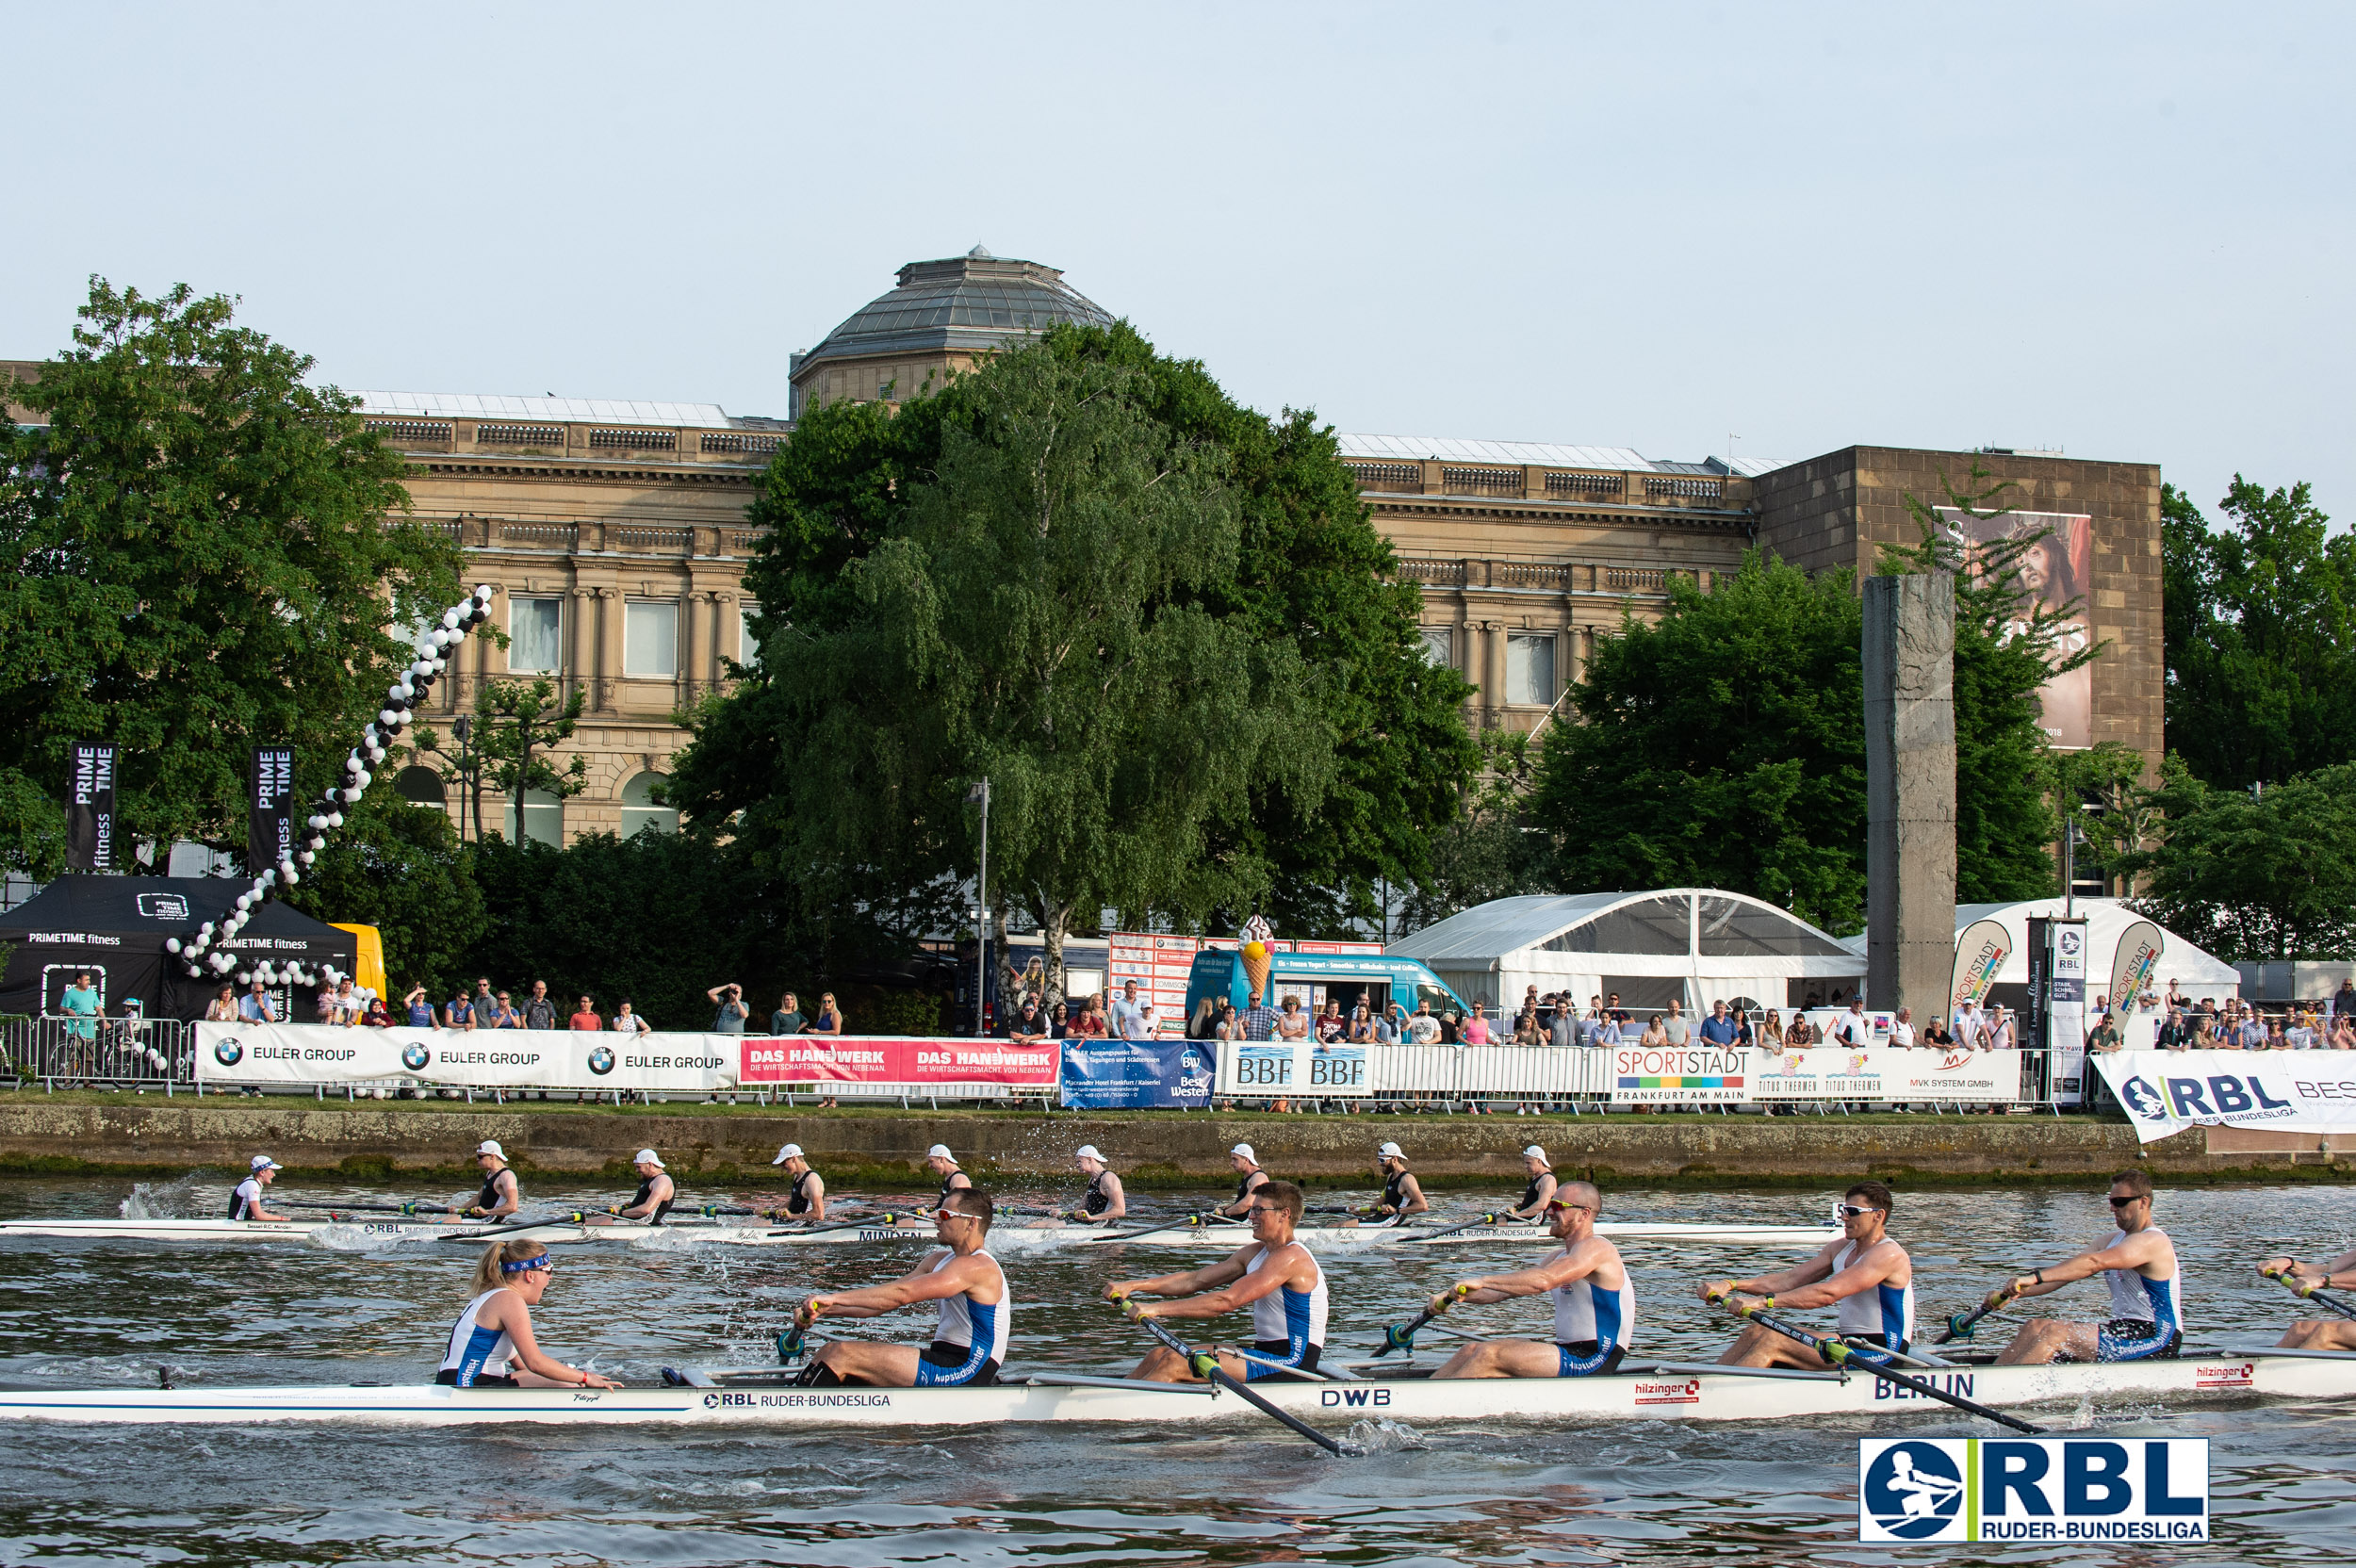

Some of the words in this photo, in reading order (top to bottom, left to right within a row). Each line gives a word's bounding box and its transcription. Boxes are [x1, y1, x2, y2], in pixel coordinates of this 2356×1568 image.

[76, 747, 94, 804] PRIME
[95, 748, 113, 792] TIME
[277, 751, 290, 796] TIME
[259, 751, 274, 809] PRIME
[94, 813, 110, 867] fitness
[276, 817, 289, 861] tness
[29, 933, 86, 943] PRIMETIME
[87, 934, 120, 946] fitness
[216, 938, 272, 949] PRIMETIME
[274, 939, 308, 949] fitness
[1989, 970, 1996, 979] AM
[1996, 952, 2008, 968] MAIN
[2059, 960, 2079, 968] RBL
[1952, 939, 1997, 1006] SPORTSTADT
[2111, 939, 2151, 1008] SPORTSTADT
[2126, 981, 2144, 1015] FRANKFURT
[2143, 970, 2150, 979] AM
[2149, 952, 2160, 968] MAIN
[254, 1047, 300, 1060] EULER
[304, 1049, 356, 1061] GROUP
[441, 1052, 488, 1064] EULER
[490, 1053, 540, 1065] GROUP
[750, 1050, 784, 1062] DAS
[789, 1046, 885, 1063] HANDWERK
[917, 1052, 951, 1064] DAS
[957, 1048, 1051, 1065] HANDWERK
[625, 1056, 671, 1068] EULER
[674, 1057, 724, 1069] GROUP
[1182, 1057, 1200, 1068] BW
[1618, 1051, 1749, 1074] SPORTSTADT
[1236, 1058, 1293, 1084] BBF
[1310, 1059, 1365, 1085] BBF
[1181, 1077, 1203, 1087] Best
[1759, 1081, 1780, 1092] TITUS
[1785, 1081, 1816, 1092] THERMEN
[1826, 1080, 1845, 1091] TITUS
[1850, 1080, 1881, 1091] THERMEN
[1618, 1092, 1685, 1100] FRANKFURT
[1714, 1091, 1744, 1099] MAIN
[2168, 1075, 2291, 1116] RBL
[377, 1224, 402, 1233] RBL
[1466, 1229, 1537, 1237] RUDER-BUNDESLIGA
[859, 1231, 922, 1242] MINDEN
[2197, 1367, 2240, 1379] hilzinger
[1636, 1383, 1684, 1396] hilzinger
[722, 1394, 757, 1405] RBL
[761, 1395, 891, 1407] RUDER-BUNDESLIGA
[1322, 1389, 1391, 1406] DWB
